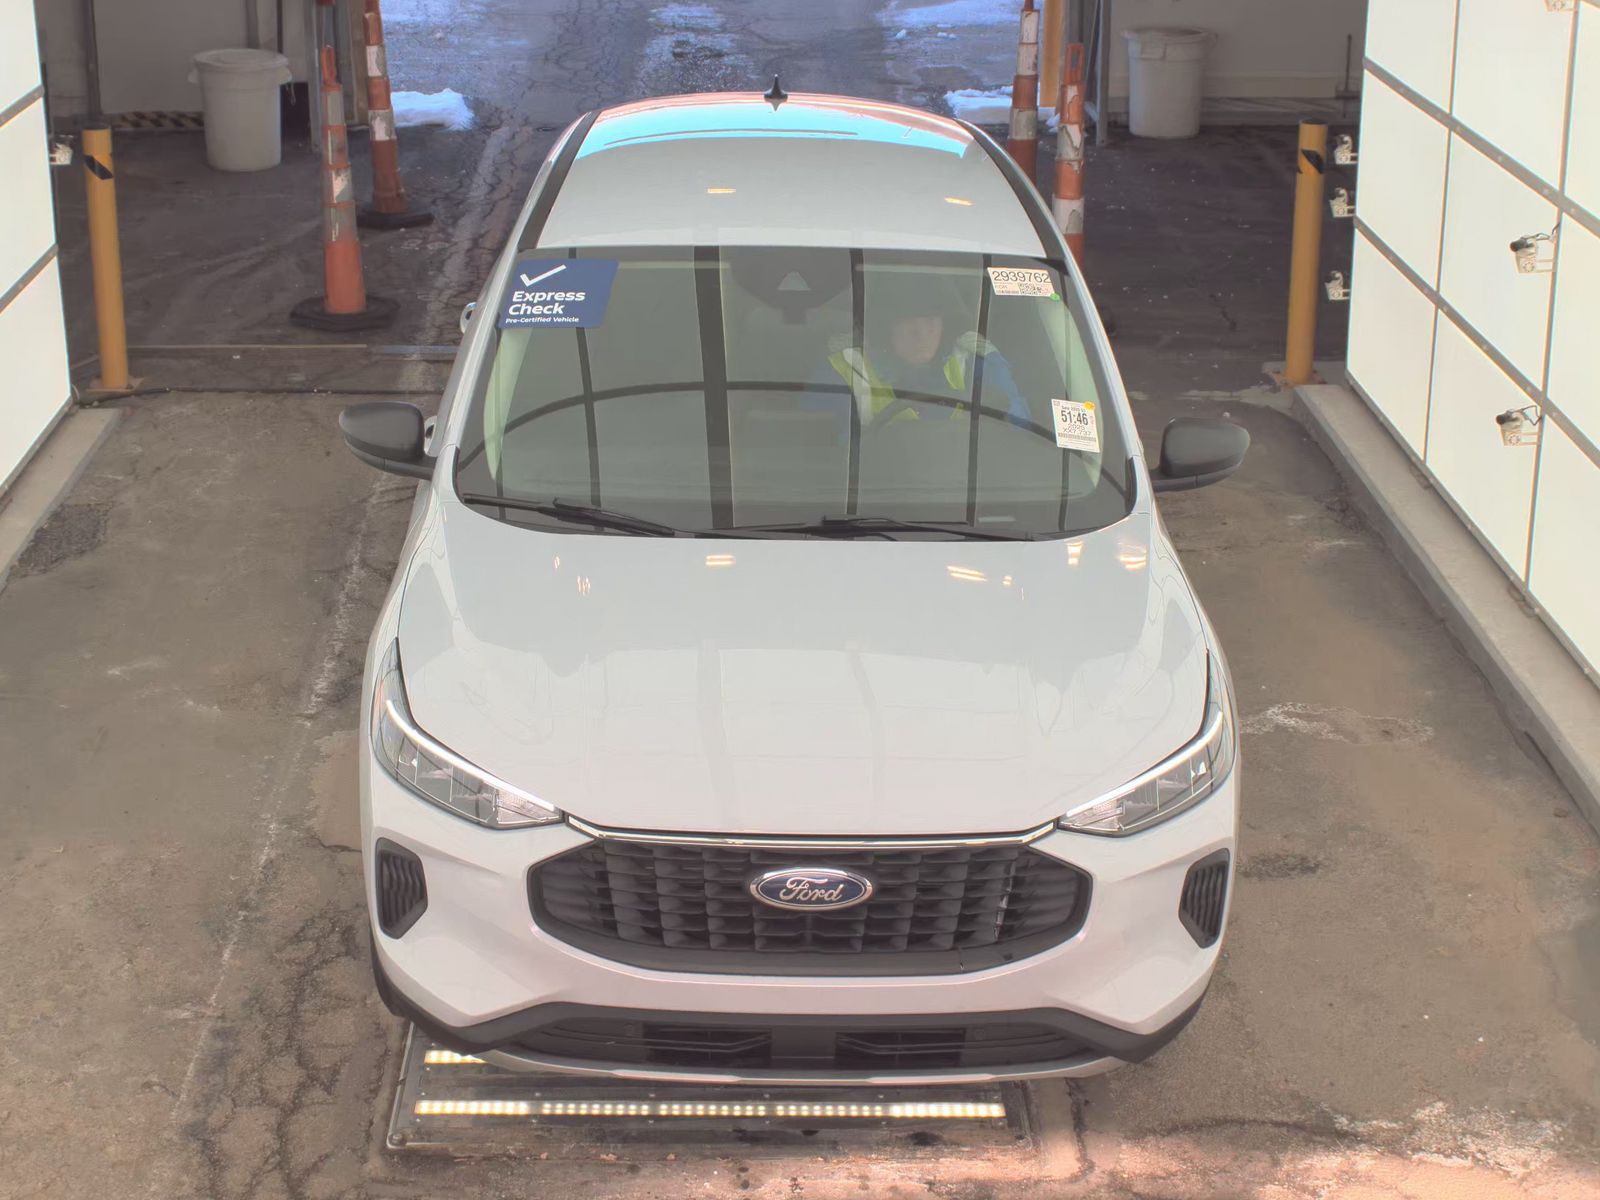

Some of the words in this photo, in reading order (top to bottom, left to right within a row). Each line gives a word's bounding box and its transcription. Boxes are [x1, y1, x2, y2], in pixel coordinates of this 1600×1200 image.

[992, 271, 1052, 284] 2939762
[512, 291, 586, 303] Express
[508, 303, 565, 315] Check
[1060, 410, 1089, 426] 51:46
[779, 876, 845, 901] Ford
